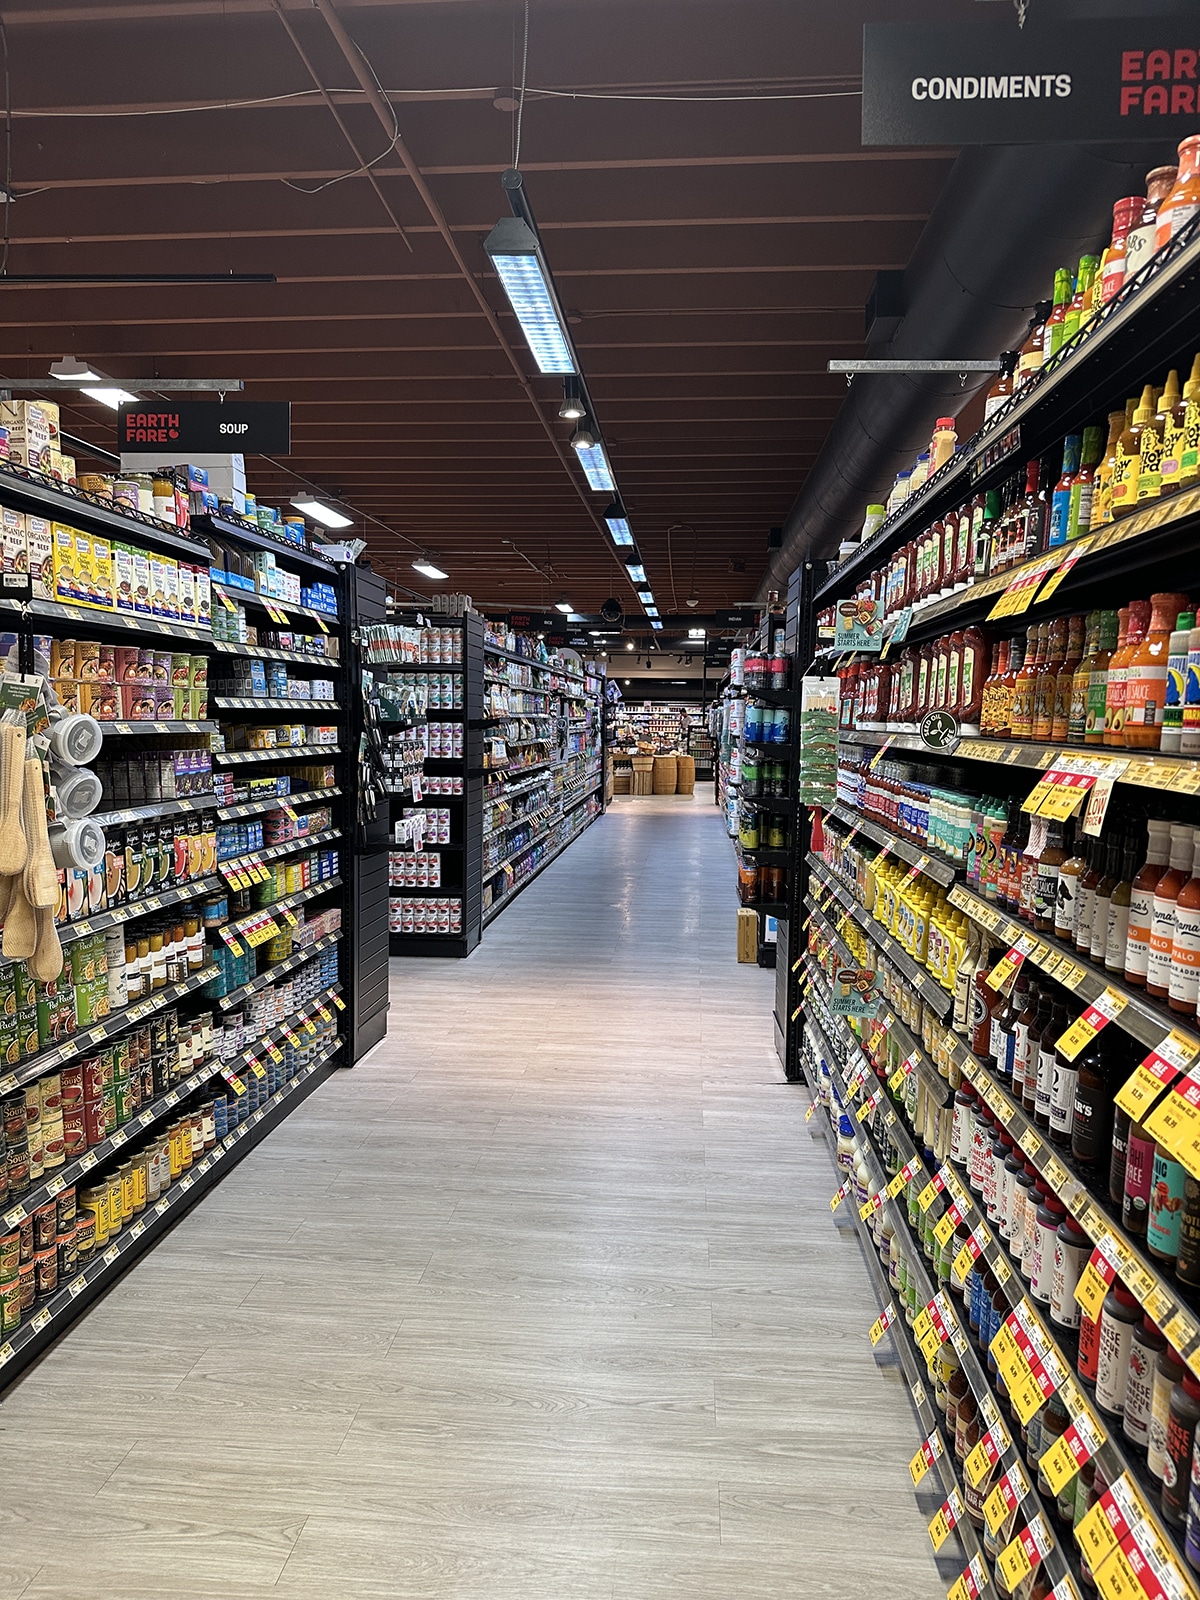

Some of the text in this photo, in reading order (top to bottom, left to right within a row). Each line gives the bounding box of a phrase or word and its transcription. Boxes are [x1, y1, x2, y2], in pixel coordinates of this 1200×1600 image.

[1121, 49, 1200, 81] EAR
[912, 74, 1072, 100] CONDIMENTS
[1120, 85, 1200, 116] FAR
[126, 414, 179, 427] EARTH
[219, 423, 248, 434] SOUP
[35, 432, 47, 440] BEEF
[126, 428, 168, 442] FARE
[10, 537, 22, 545] BEEF
[941, 729, 954, 745] FREE
[1088, 798, 1107, 815] LOW
[1086, 816, 1098, 826] PRICE
[1088, 1011, 1101, 1024] SALE
[1151, 1059, 1168, 1075] SALE
[1141, 1073, 1152, 1084] Save
[1185, 1084, 1200, 1102] SALE
[1175, 1100, 1187, 1112] Save
[1096, 1257, 1108, 1274] SALE
[1011, 1318, 1019, 1335] SALE
[1023, 1344, 1034, 1360] SALE
[1038, 1371, 1049, 1388] SALE
[985, 1440, 995, 1454] SALE
[1070, 1435, 1083, 1454] SALE
[1062, 1447, 1070, 1460] Save
[1003, 1483, 1013, 1501] SALE
[1107, 1501, 1121, 1527] SALE
[1099, 1517, 1107, 1531] Save
[1024, 1536, 1035, 1556] SALE
[1127, 1547, 1146, 1572] SALE
